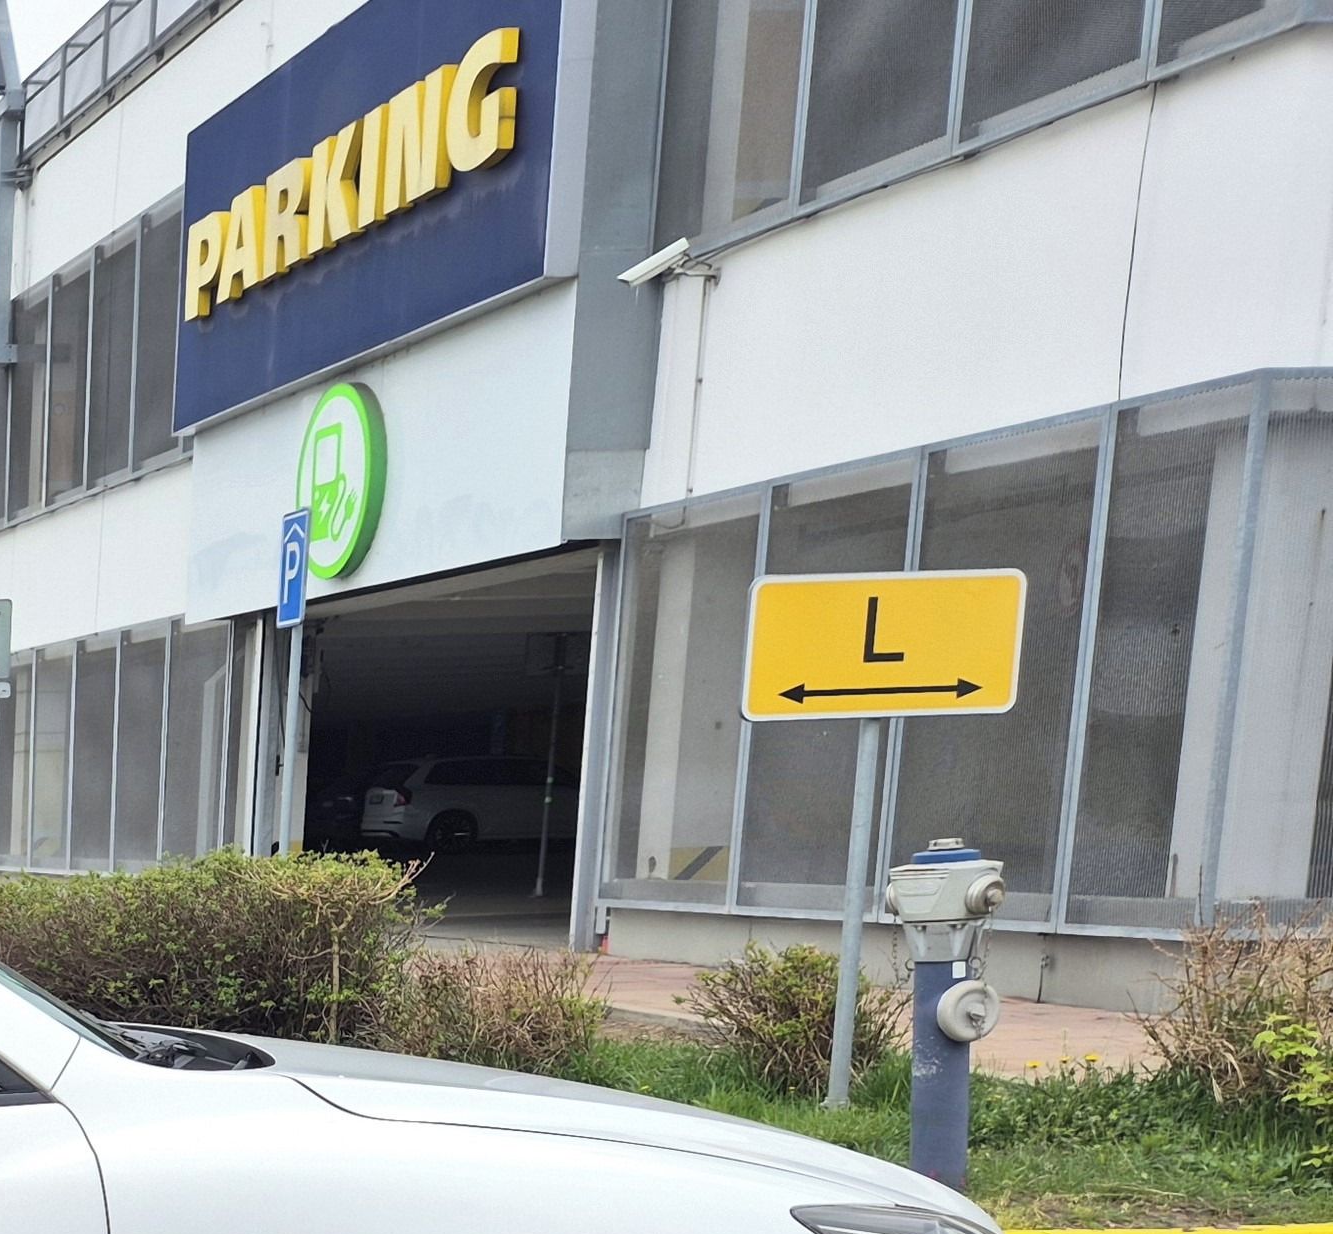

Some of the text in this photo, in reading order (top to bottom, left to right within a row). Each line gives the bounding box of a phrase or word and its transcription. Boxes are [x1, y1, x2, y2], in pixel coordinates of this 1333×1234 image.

[184, 27, 520, 322] PARKING
[283, 542, 300, 604] P
[863, 596, 904, 663] L
